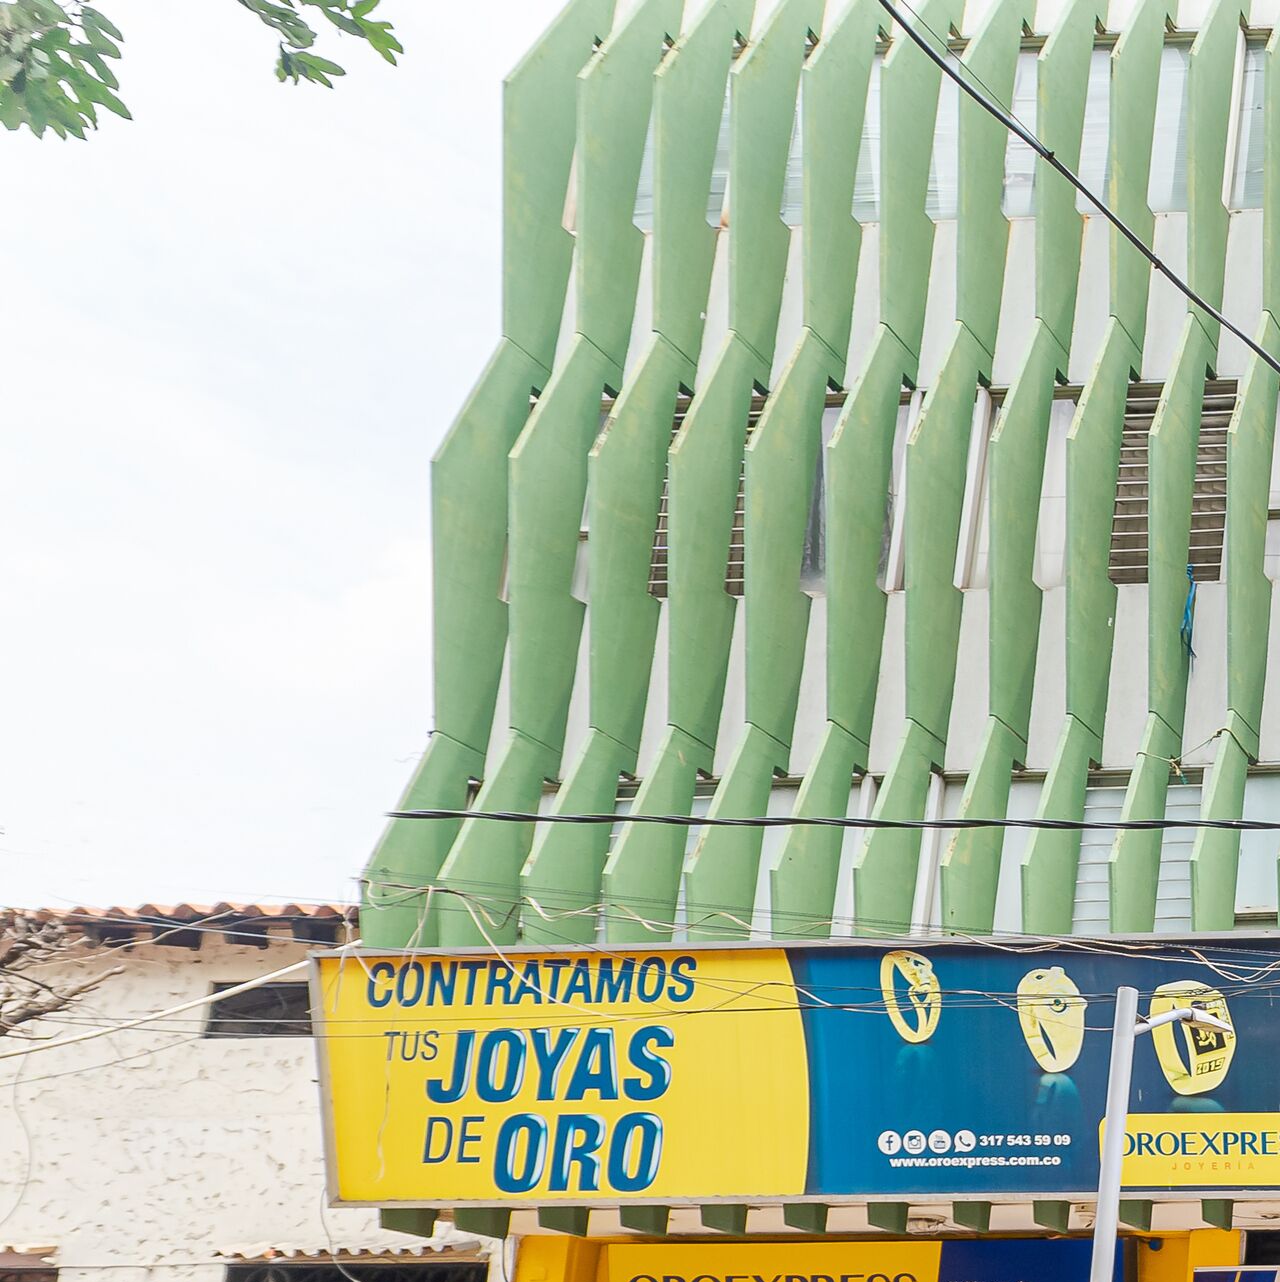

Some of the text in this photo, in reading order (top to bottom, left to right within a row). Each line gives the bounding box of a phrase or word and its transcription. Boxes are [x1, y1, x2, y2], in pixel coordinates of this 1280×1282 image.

[367, 955, 698, 1009] CONTRATAMOS
[385, 1025, 675, 1104] TUS JOYAS
[422, 1111, 664, 1194] DE ORO
[889, 1155, 1062, 1169] www.oroexpress.com.co
[979, 1134, 1072, 1147] 317 543 59 09
